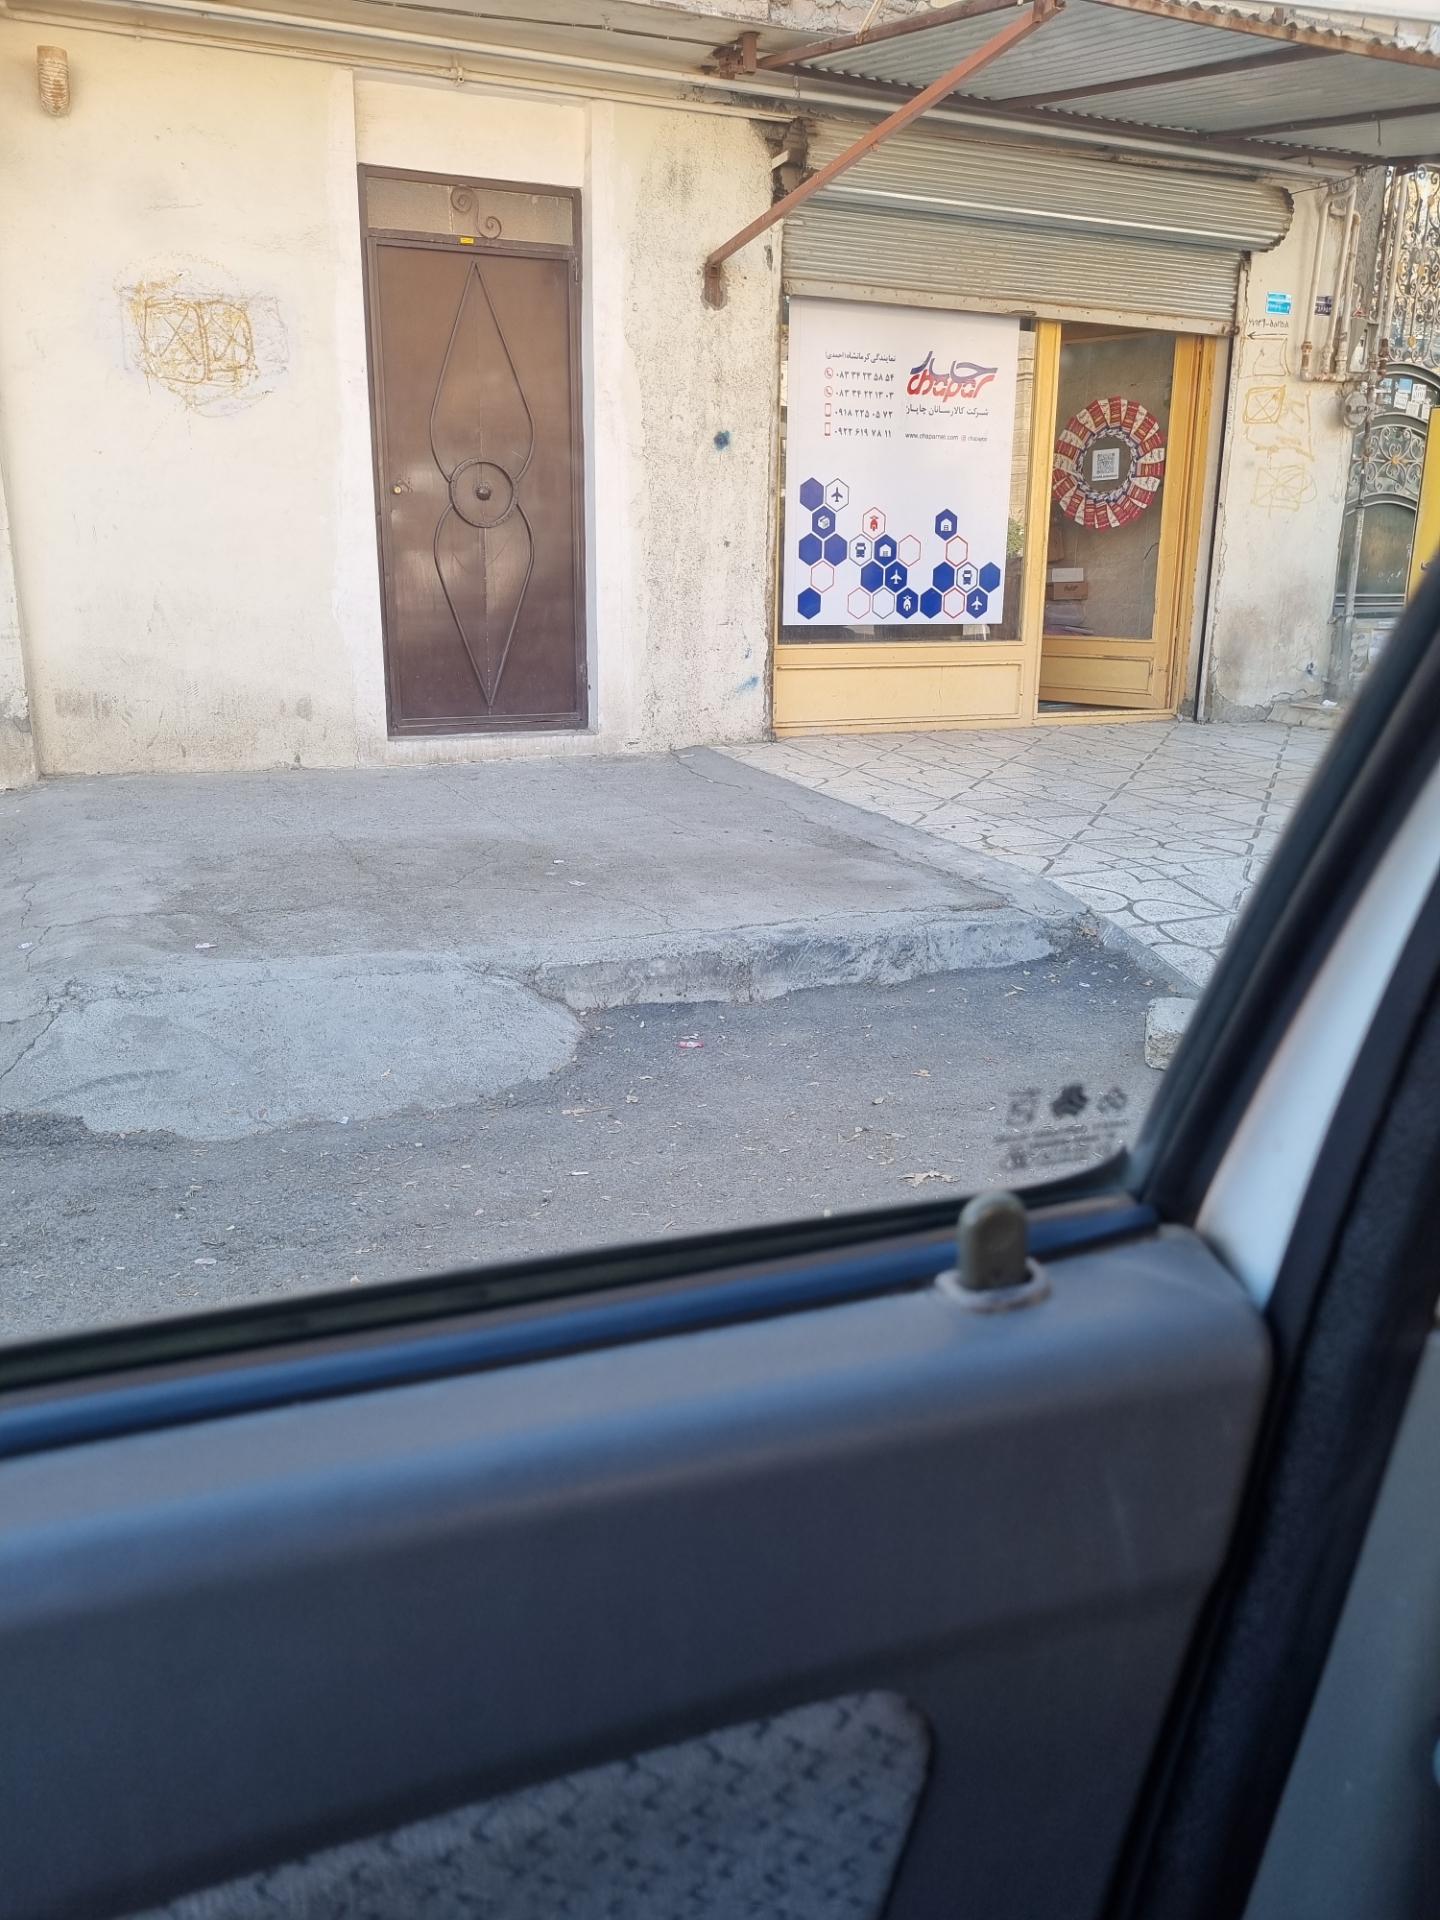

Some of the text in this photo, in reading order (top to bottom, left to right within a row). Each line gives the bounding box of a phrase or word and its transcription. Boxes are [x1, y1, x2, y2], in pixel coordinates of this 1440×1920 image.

[907, 369, 995, 402] chapar
[906, 404, 927, 415] چاپار
[966, 408, 989, 418] شرکت
